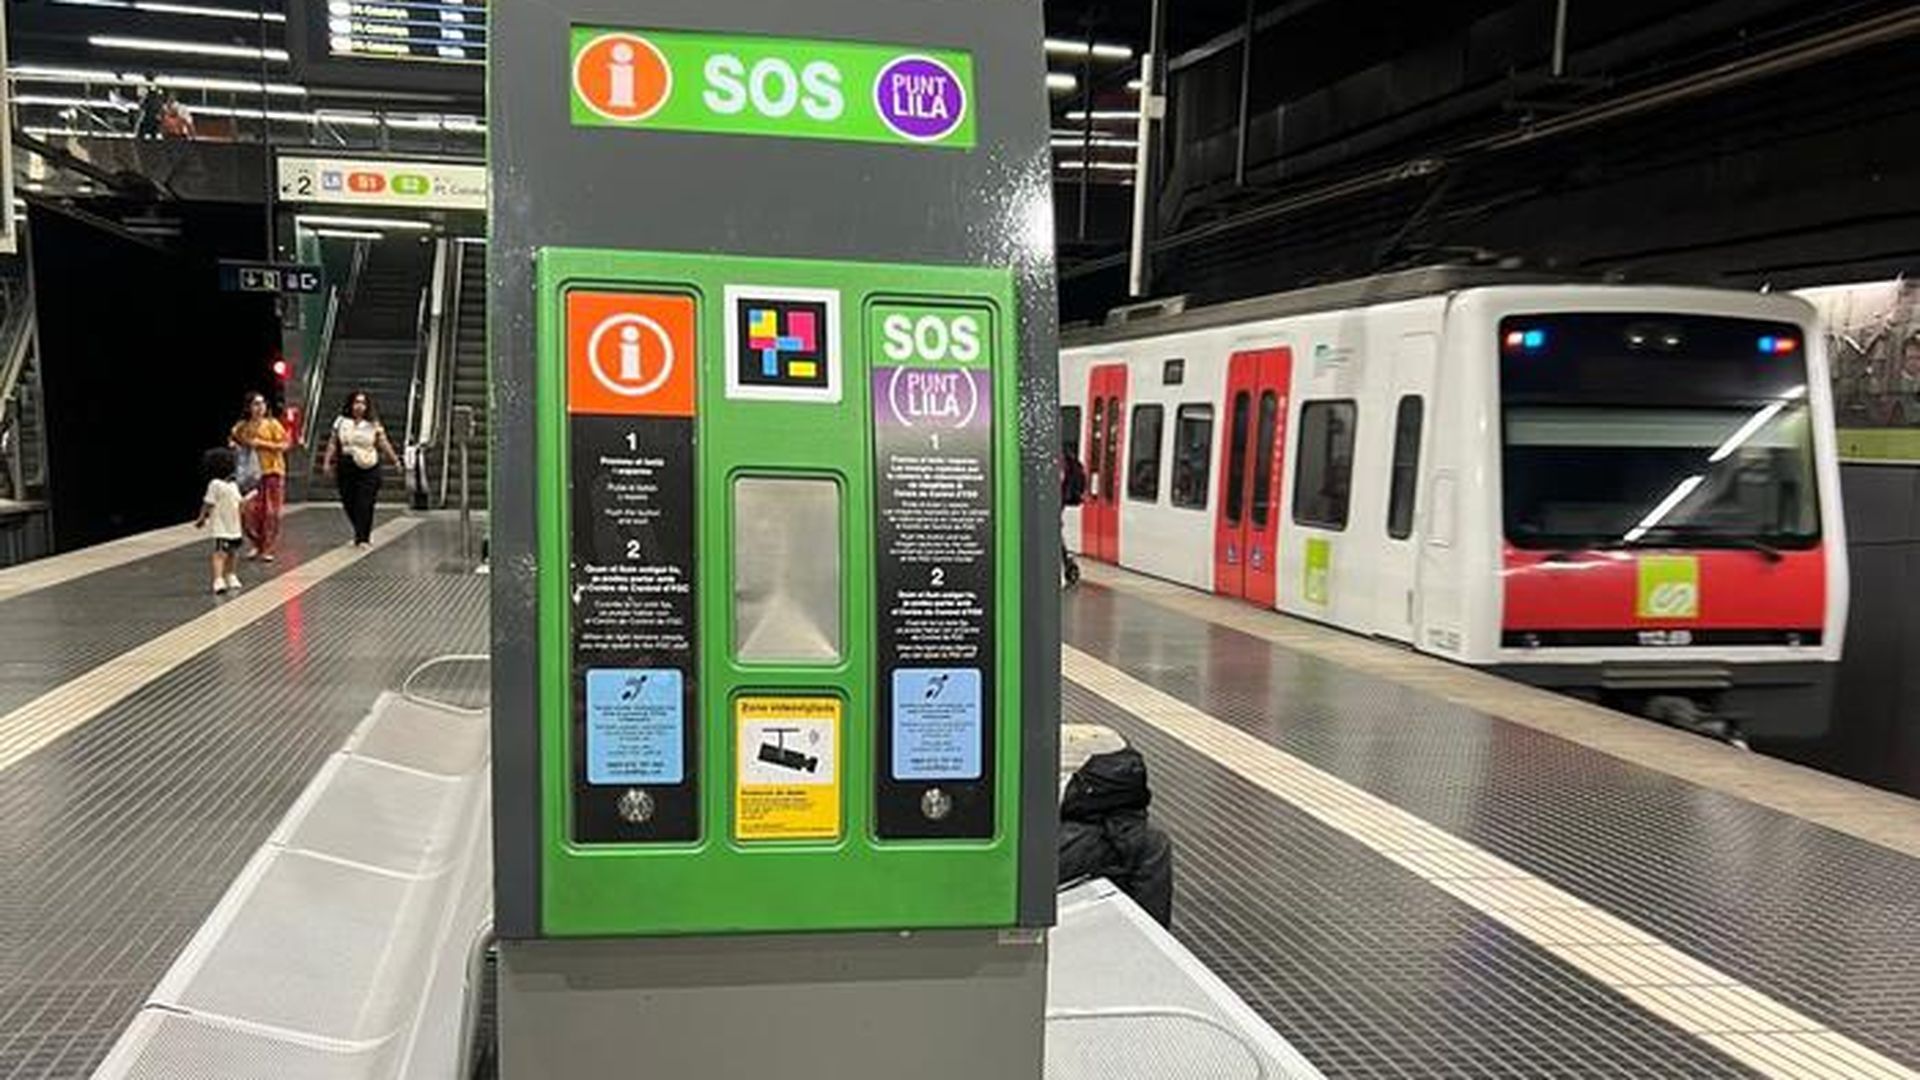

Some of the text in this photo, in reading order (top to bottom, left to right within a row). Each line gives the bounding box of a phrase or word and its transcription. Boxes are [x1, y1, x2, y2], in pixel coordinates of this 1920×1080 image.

[703, 53, 845, 121] SOS
[892, 73, 947, 97] PUNT
[893, 94, 948, 119] LILA
[298, 176, 312, 195] 2
[883, 314, 980, 361] SOS
[907, 372, 959, 394] PUNT
[908, 393, 960, 417] LILA
[626, 432, 637, 450] 1
[931, 434, 939, 450] 1
[627, 540, 640, 558] 2
[931, 567, 944, 585] 2
